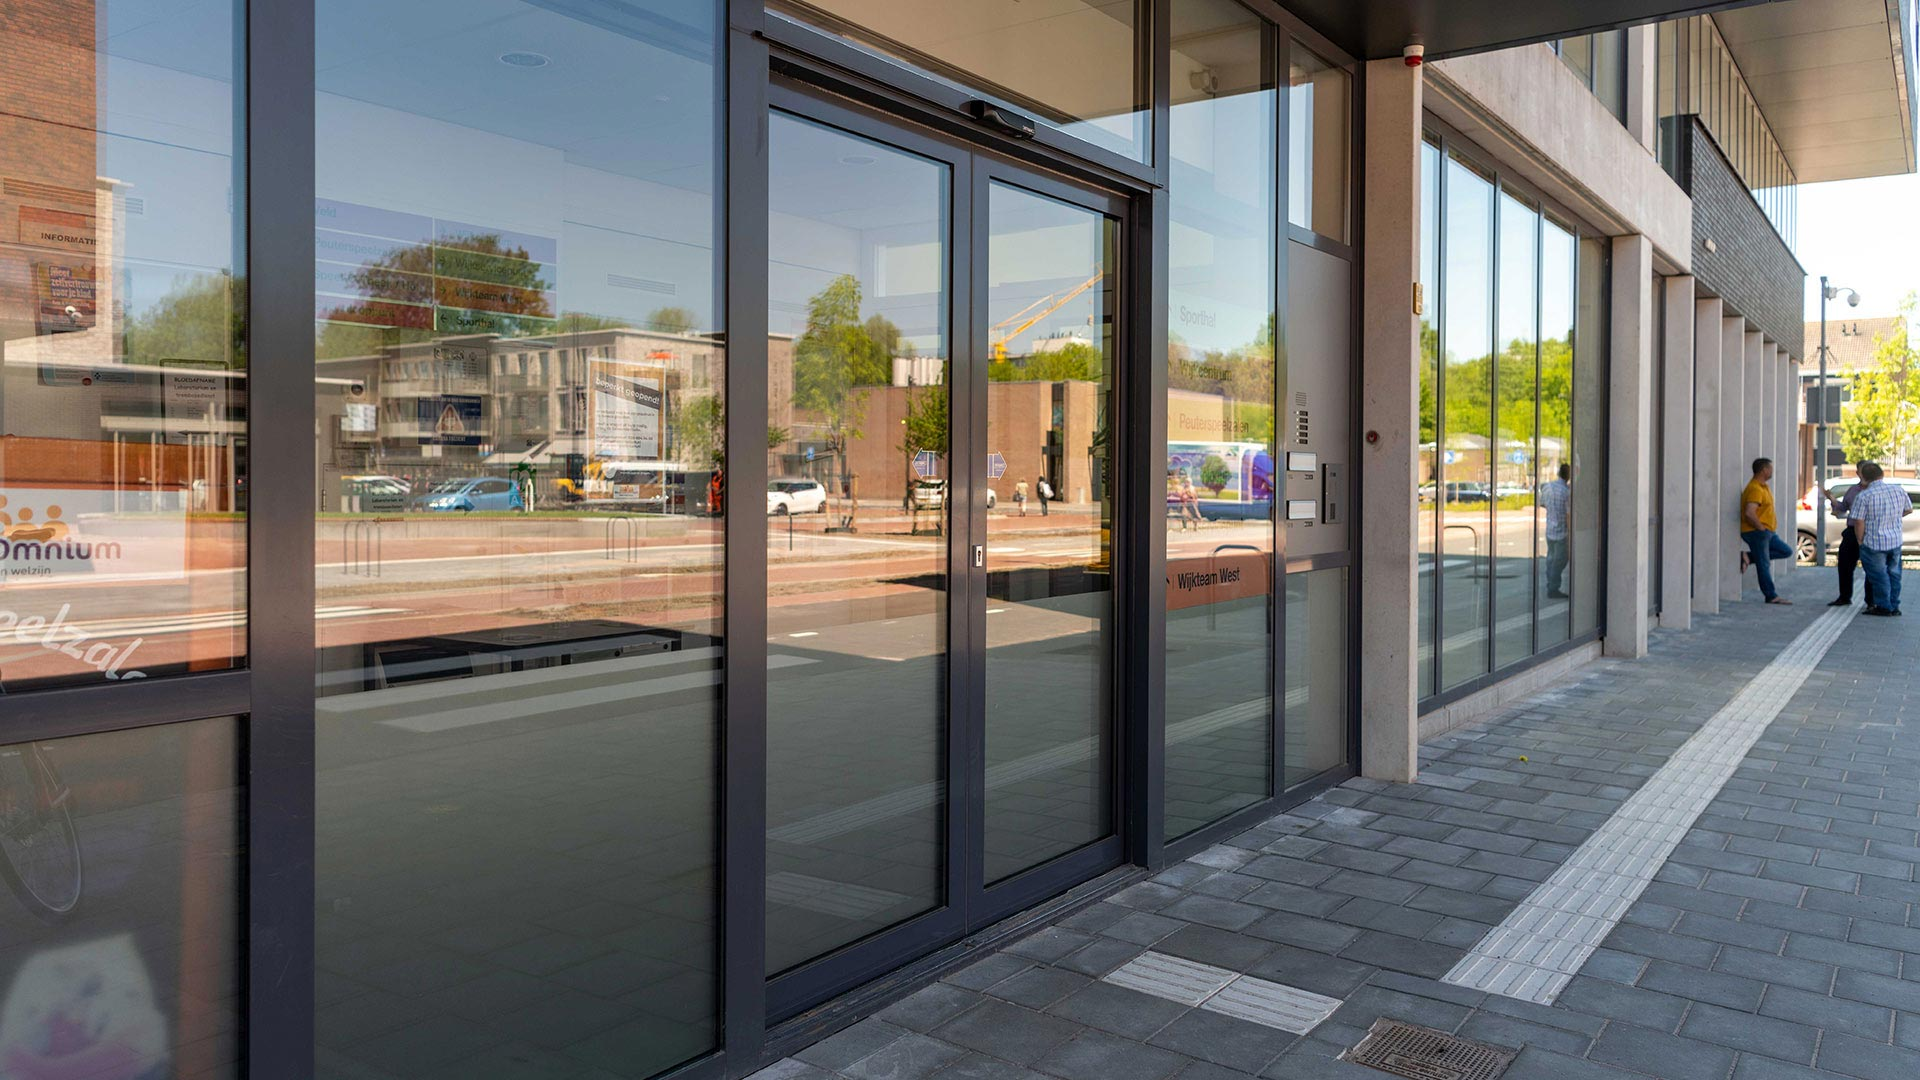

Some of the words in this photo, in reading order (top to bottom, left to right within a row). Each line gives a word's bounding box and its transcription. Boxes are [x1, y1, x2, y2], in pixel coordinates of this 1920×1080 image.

[456, 315, 495, 331] Sporthal
[1179, 304, 1216, 329] Sporthal
[595, 376, 625, 395] beperkt
[625, 387, 660, 406] geopend!
[1179, 412, 1249, 434] Peuterspeelzalen
[10, 566, 51, 577] welzijn
[1177, 571, 1218, 592] Wijkteam
[1219, 565, 1240, 584] West
